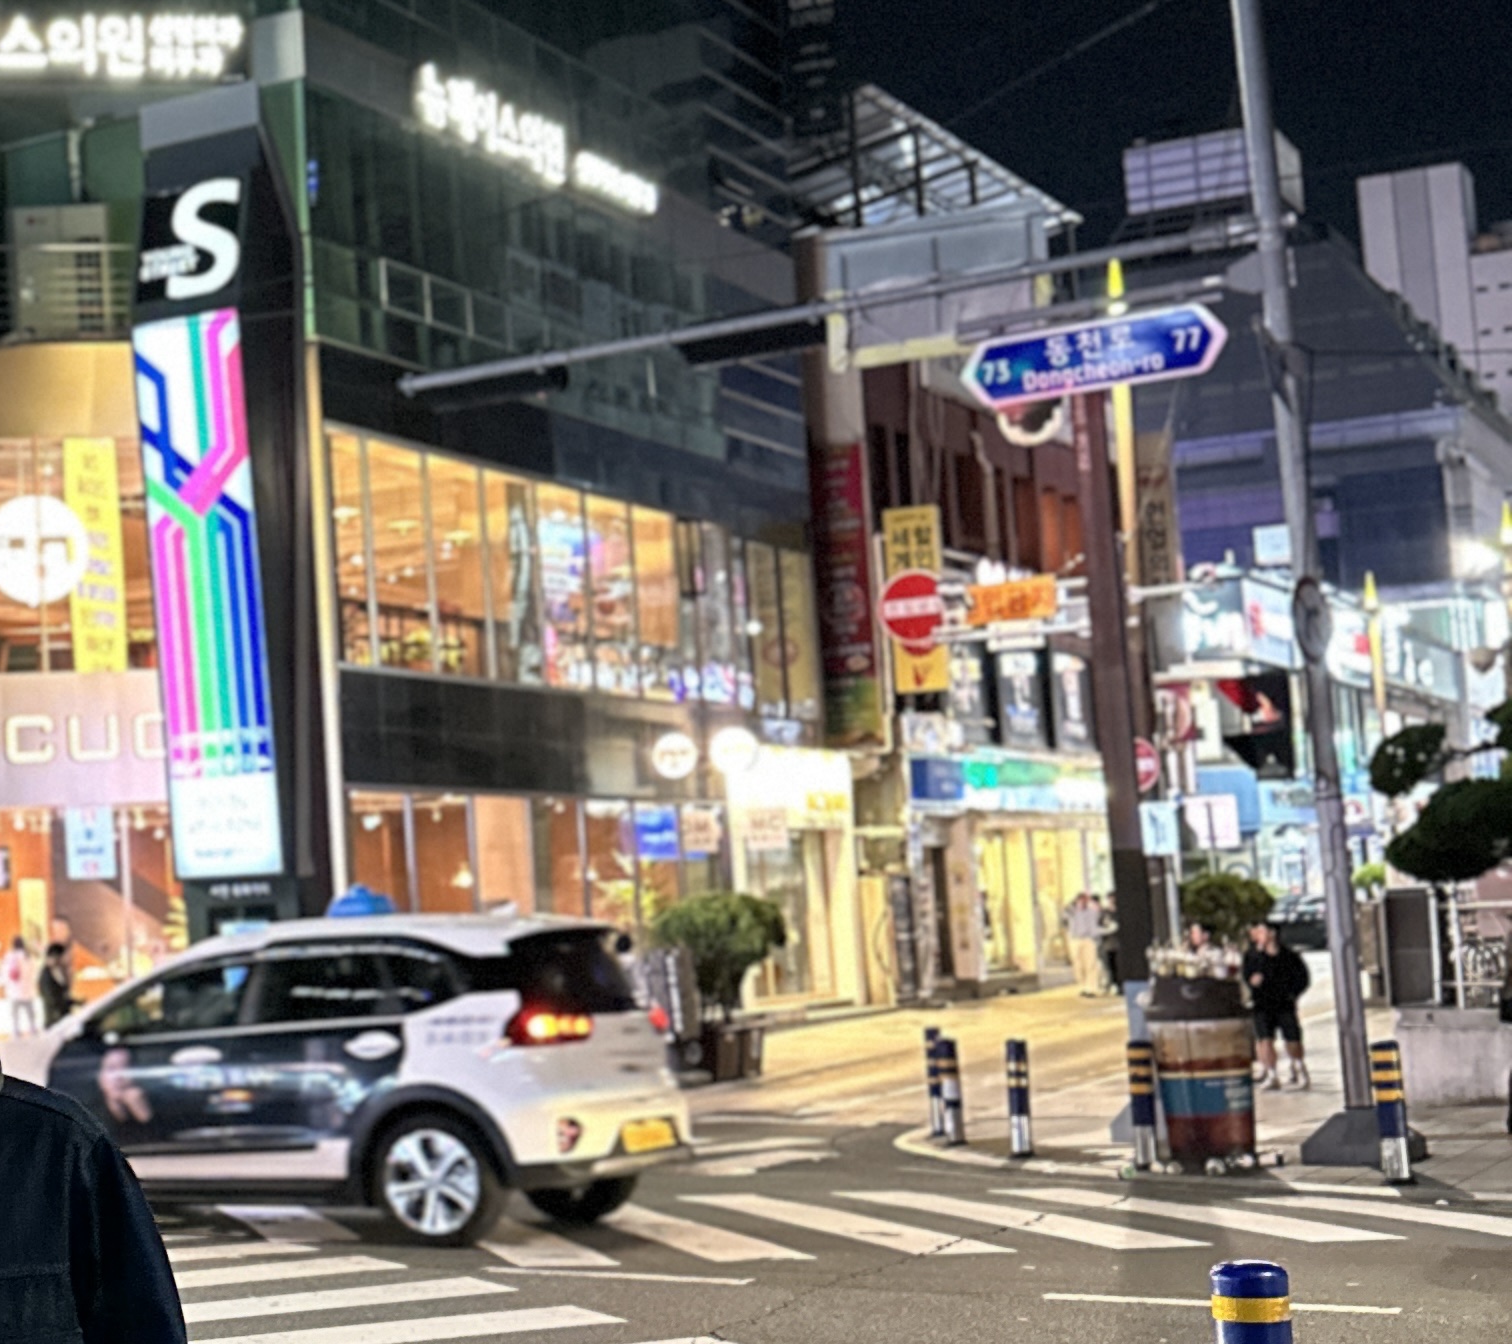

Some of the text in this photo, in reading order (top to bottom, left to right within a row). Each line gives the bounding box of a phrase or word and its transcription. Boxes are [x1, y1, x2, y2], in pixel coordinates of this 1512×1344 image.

[164, 177, 241, 299] S
[1044, 323, 1136, 367] 동천로
[1170, 326, 1203, 353] 77
[980, 359, 1012, 387] 73
[1021, 353, 1165, 393] Dongcheon-ro
